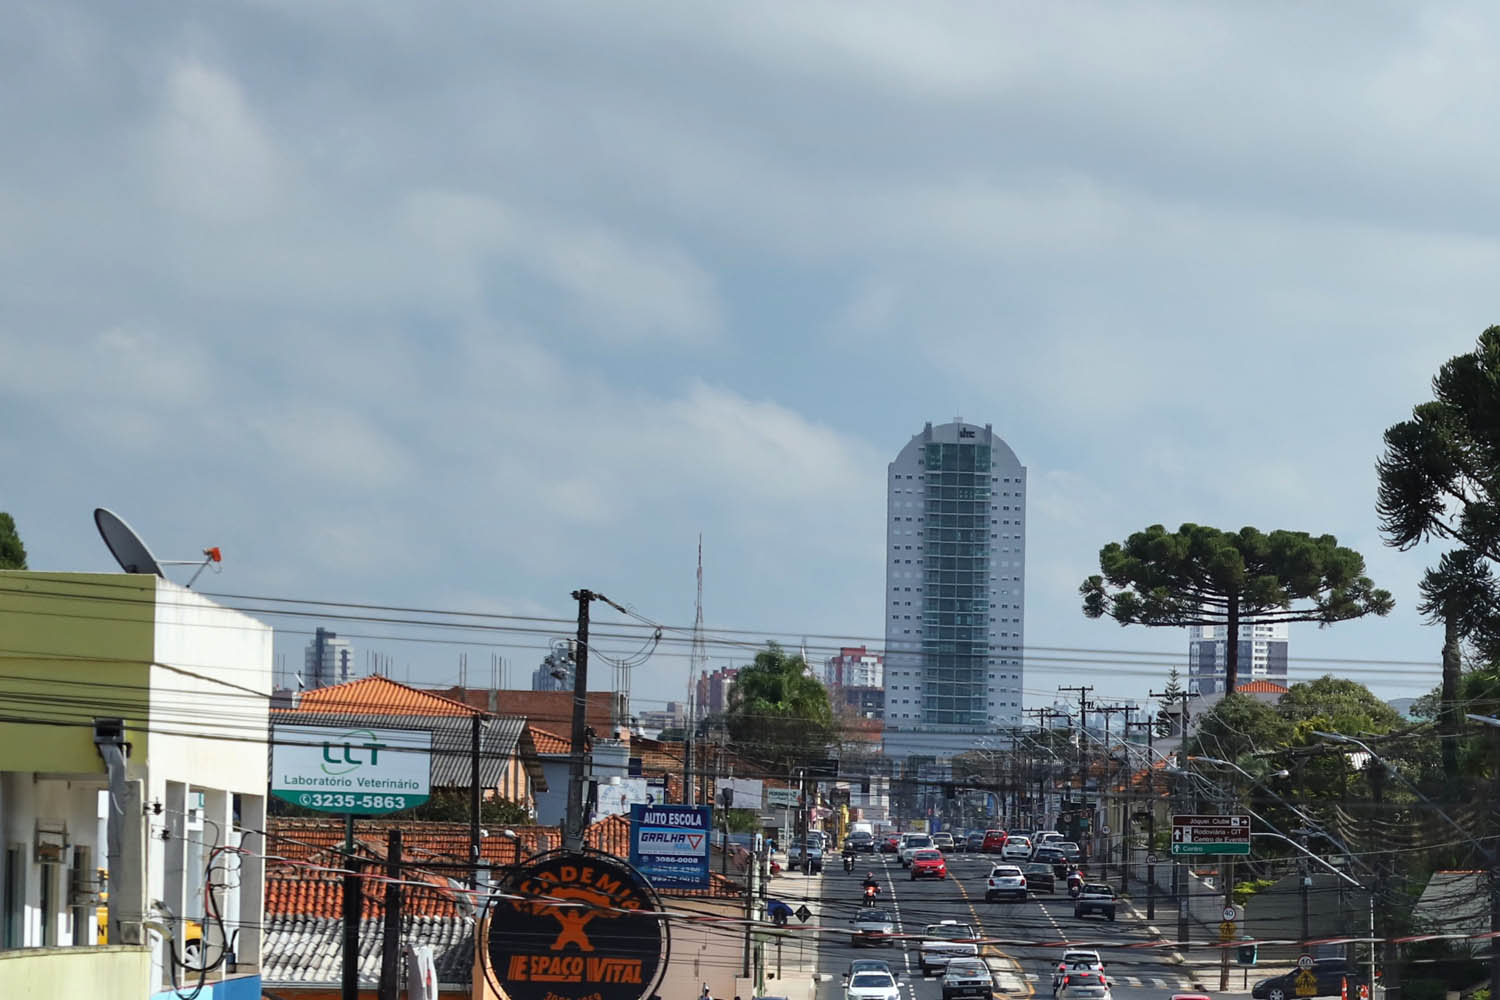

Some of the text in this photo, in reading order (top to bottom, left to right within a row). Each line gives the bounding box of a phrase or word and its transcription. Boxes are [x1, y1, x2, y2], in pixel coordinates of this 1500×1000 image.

[284, 775, 420, 790] Laboratório Veterinário
[312, 794, 406, 808] 3235-5863
[644, 812, 702, 826] AUTO ESCOLA
[641, 832, 686, 843] GRALHA
